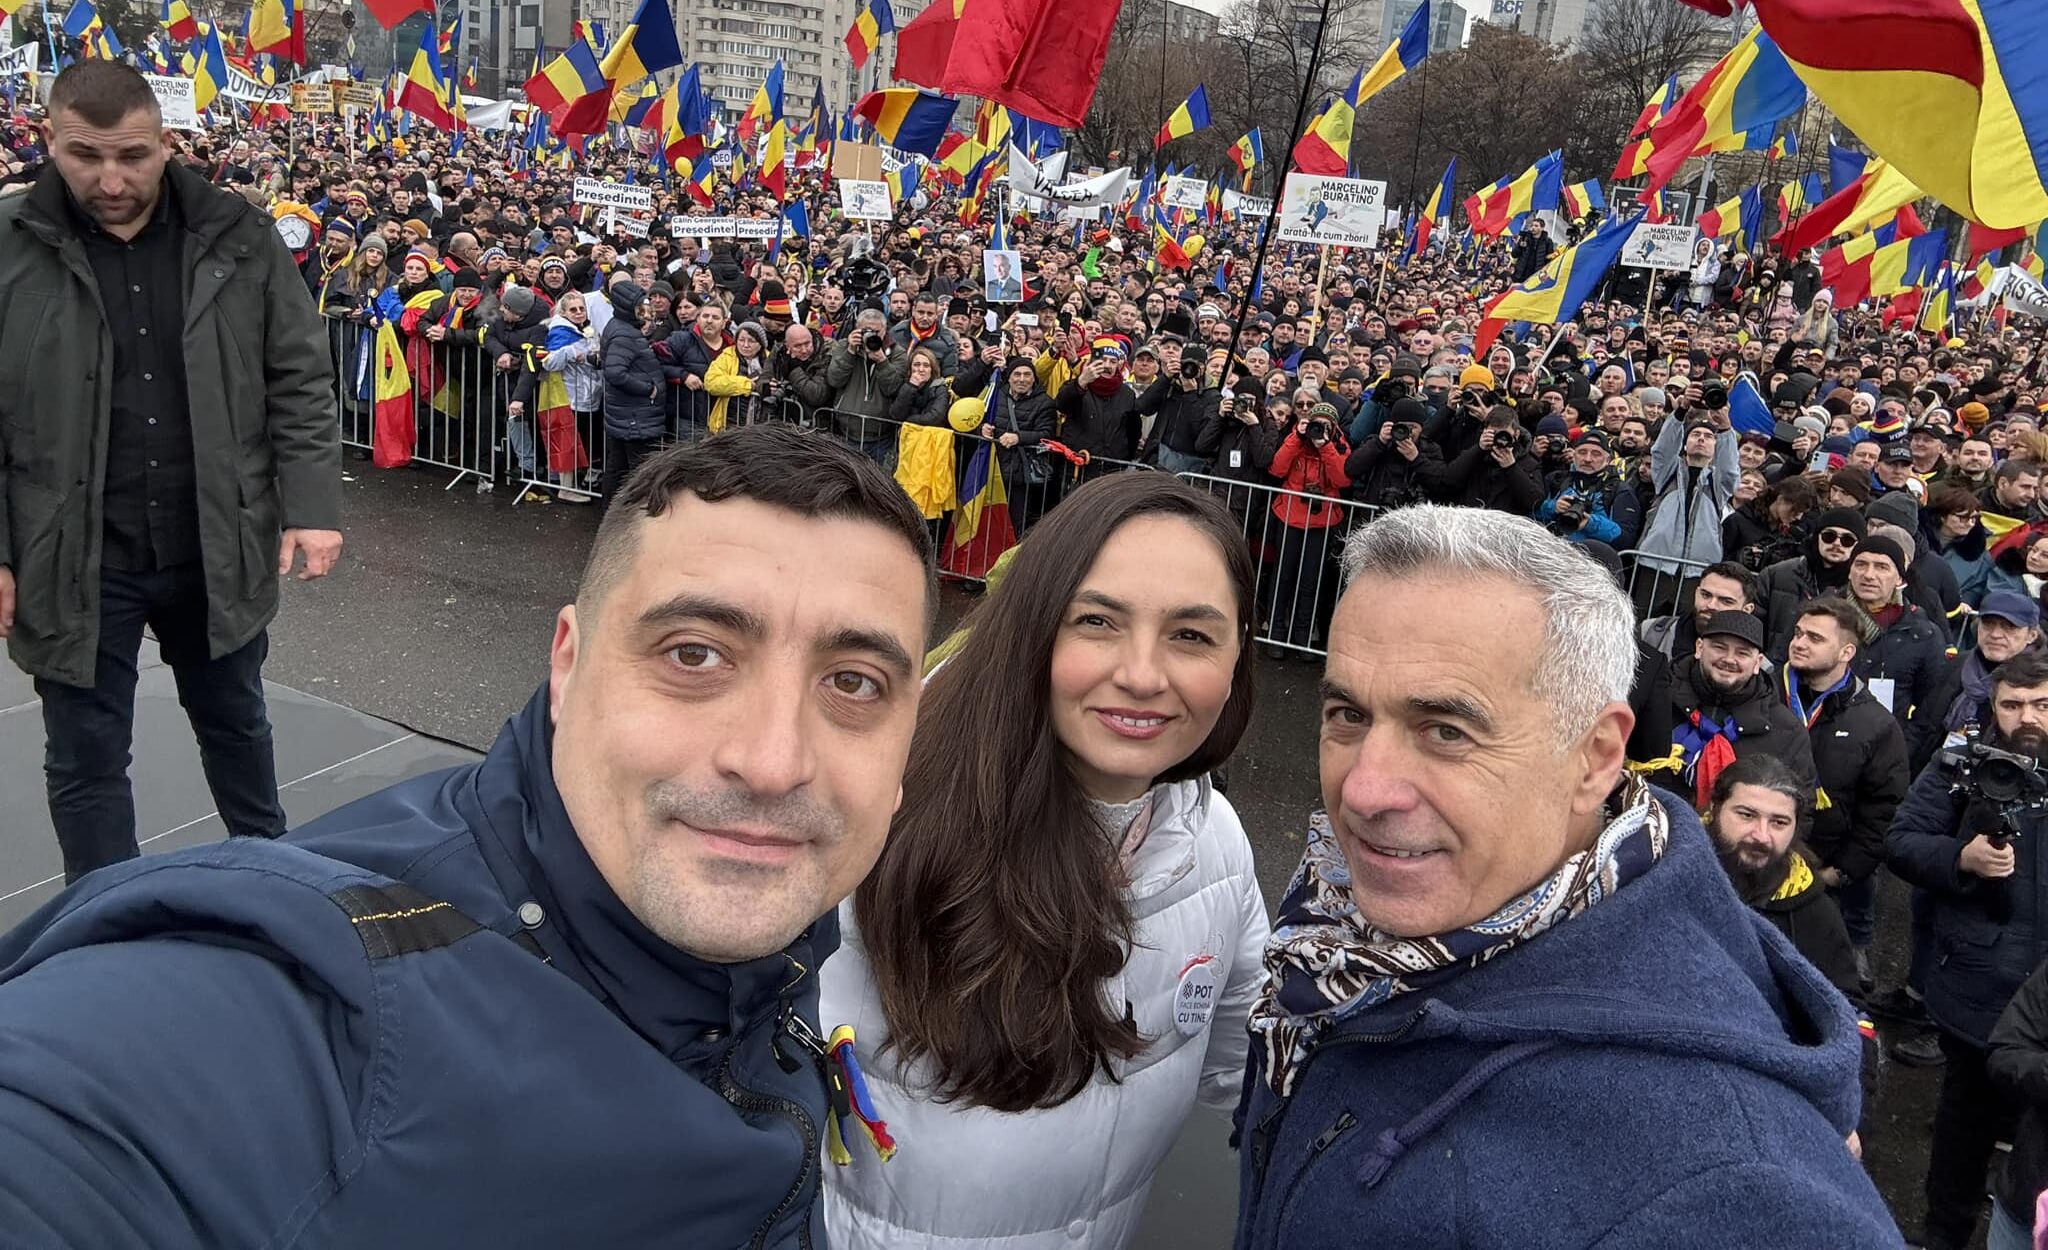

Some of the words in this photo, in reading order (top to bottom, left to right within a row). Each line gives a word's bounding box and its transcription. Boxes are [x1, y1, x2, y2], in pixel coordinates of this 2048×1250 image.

[1493, 0, 1524, 13] BCR
[151, 80, 189, 90] ARCELINO
[575, 178, 599, 188] Călin
[601, 182, 650, 195] Georgescu
[1320, 181, 1379, 196] MARCELINO
[575, 188, 649, 207] Președinte!
[1322, 190, 1374, 205] BURATINO
[1239, 196, 1272, 213] COVA
[674, 225, 735, 236] Președinte!
[1650, 227, 1691, 237] MARCELINO
[1323, 232, 1343, 240] cum
[1344, 233, 1369, 243] zbori!
[1651, 233, 1688, 242] BURATINO
[1194, 984, 1214, 998] POT
[1178, 1012, 1190, 1023] CU
[1191, 1012, 1207, 1023] TINE
